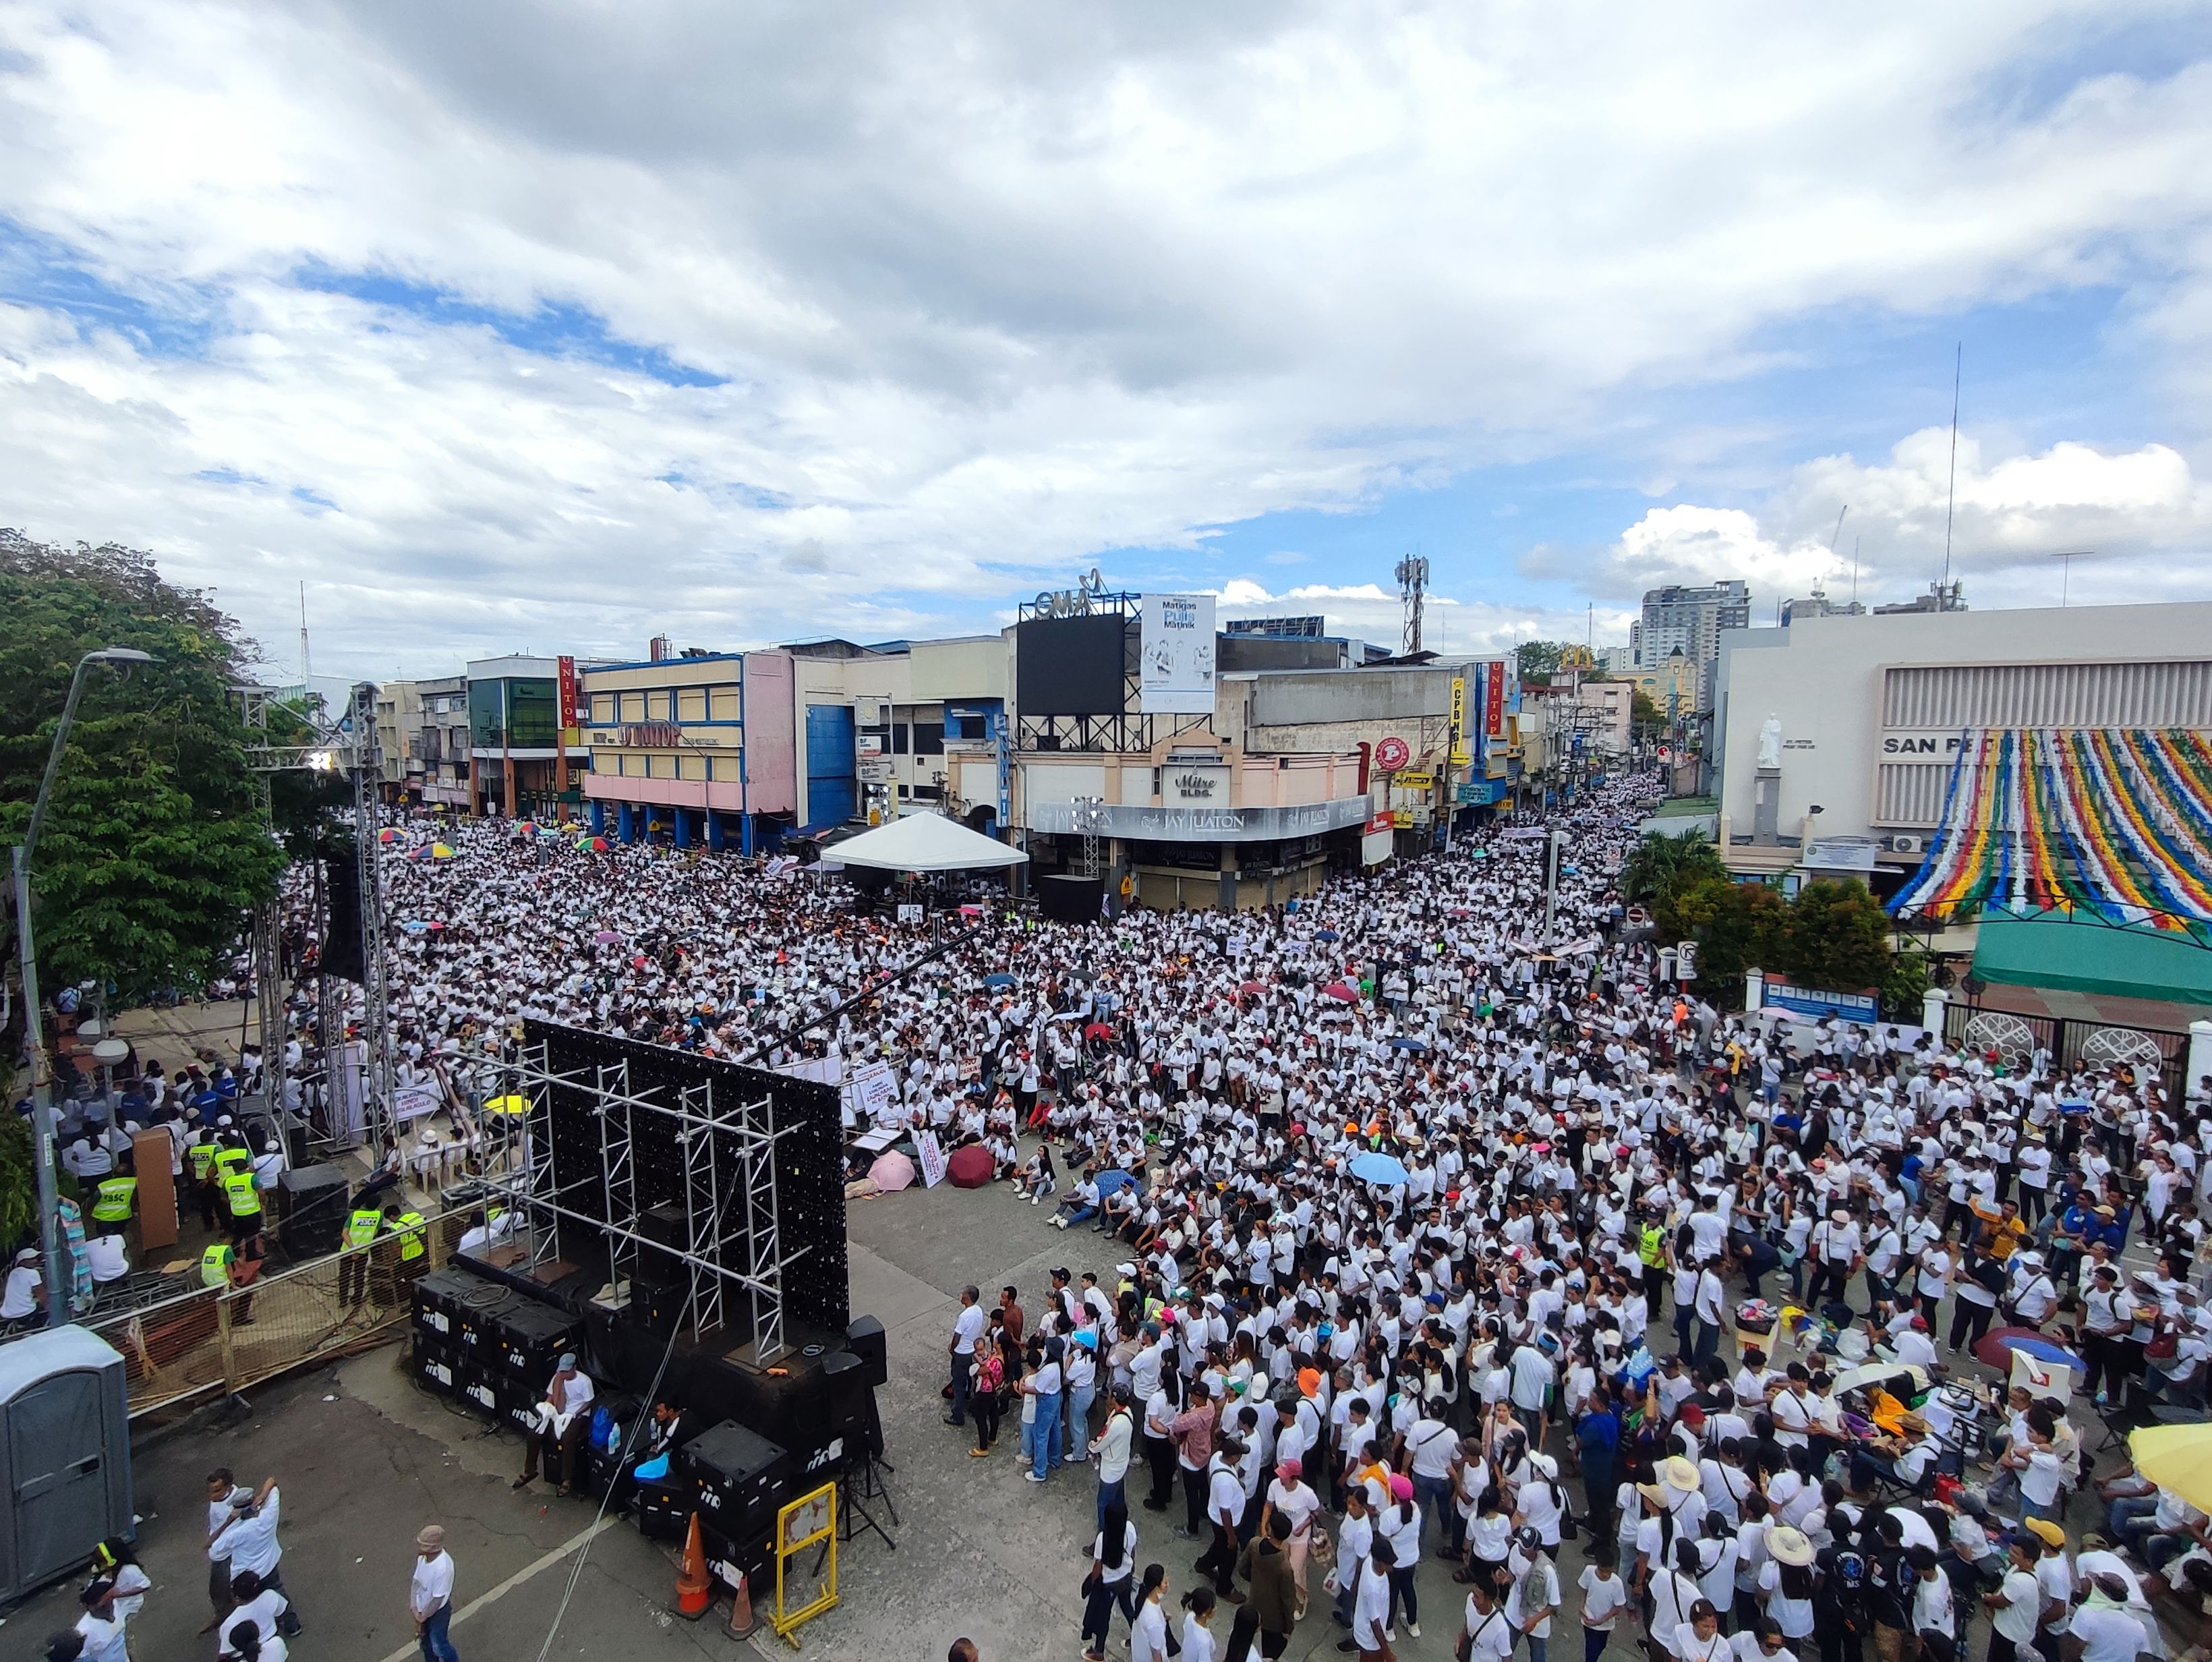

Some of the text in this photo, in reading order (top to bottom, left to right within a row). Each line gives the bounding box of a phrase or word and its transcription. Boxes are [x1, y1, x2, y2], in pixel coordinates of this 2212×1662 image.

[1035, 589, 1092, 617] GMA
[1163, 601, 1196, 611] Matigas
[1165, 621, 1195, 629] Matinik
[562, 656, 573, 728] UNITOP
[1489, 663, 1501, 734] UNITOP
[1884, 739, 1936, 753] SAN
[1175, 775, 1217, 788] Mitre
[1180, 789, 1213, 797] BLDG.
[1164, 815, 1245, 830] JAY JUATON
